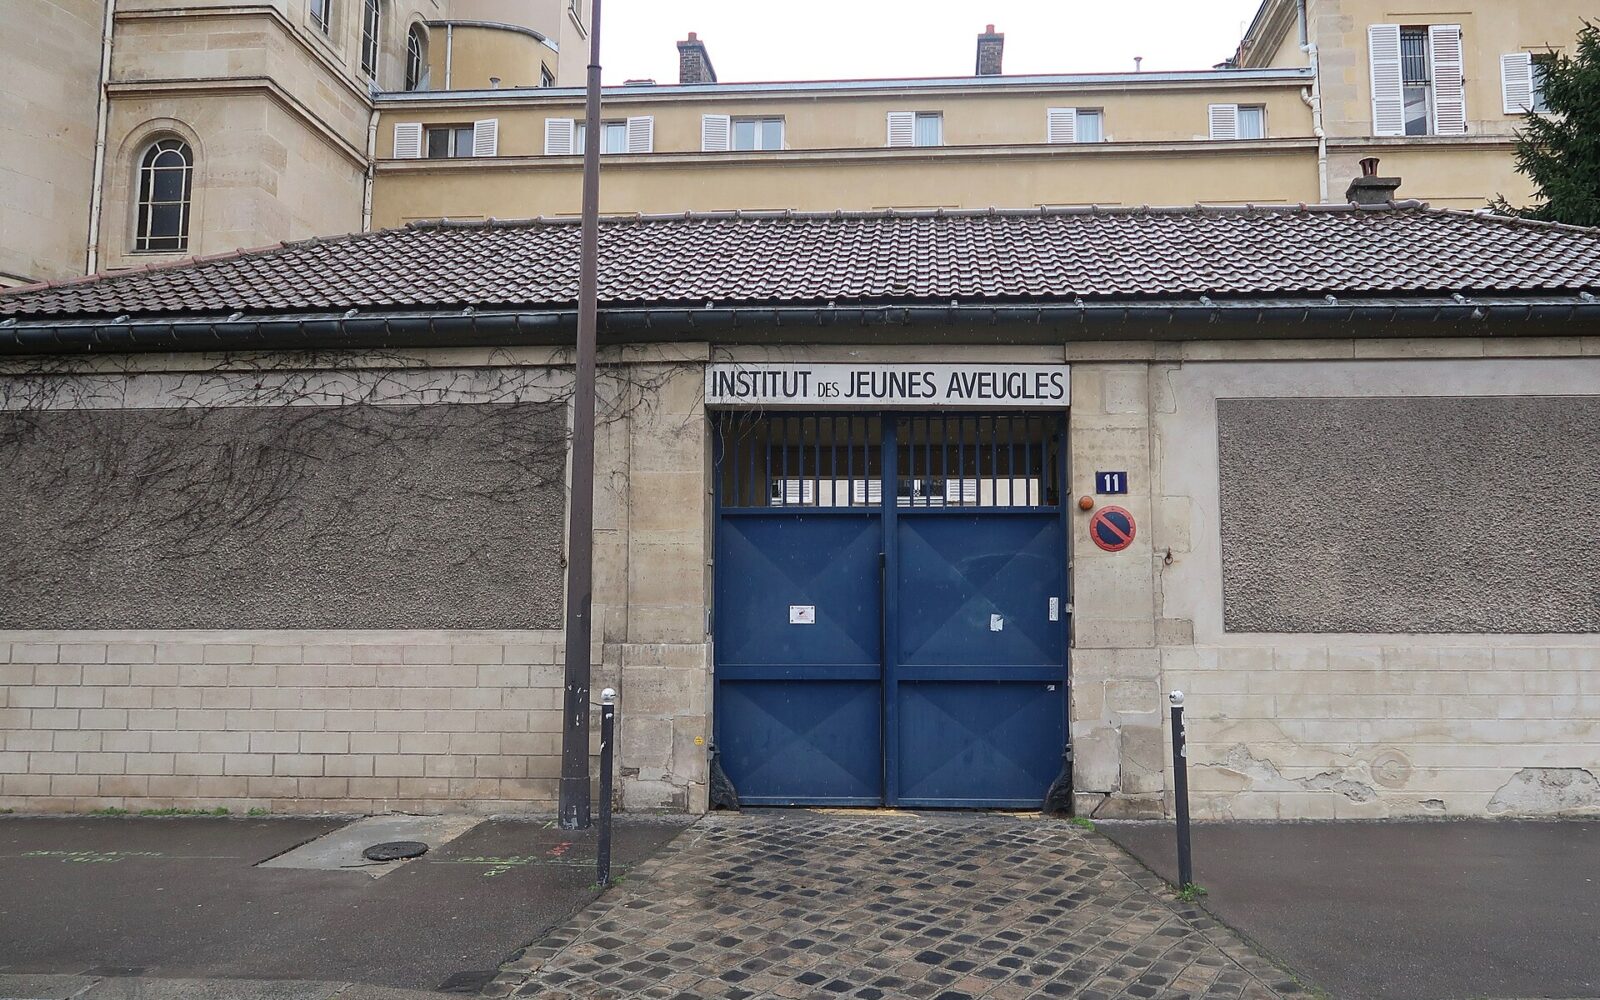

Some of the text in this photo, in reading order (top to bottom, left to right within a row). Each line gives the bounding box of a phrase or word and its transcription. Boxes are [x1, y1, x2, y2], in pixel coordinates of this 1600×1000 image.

[712, 370, 1064, 400] INSTITUT DES JEUNES AVEUGLES
[1104, 473, 1119, 492] 11
